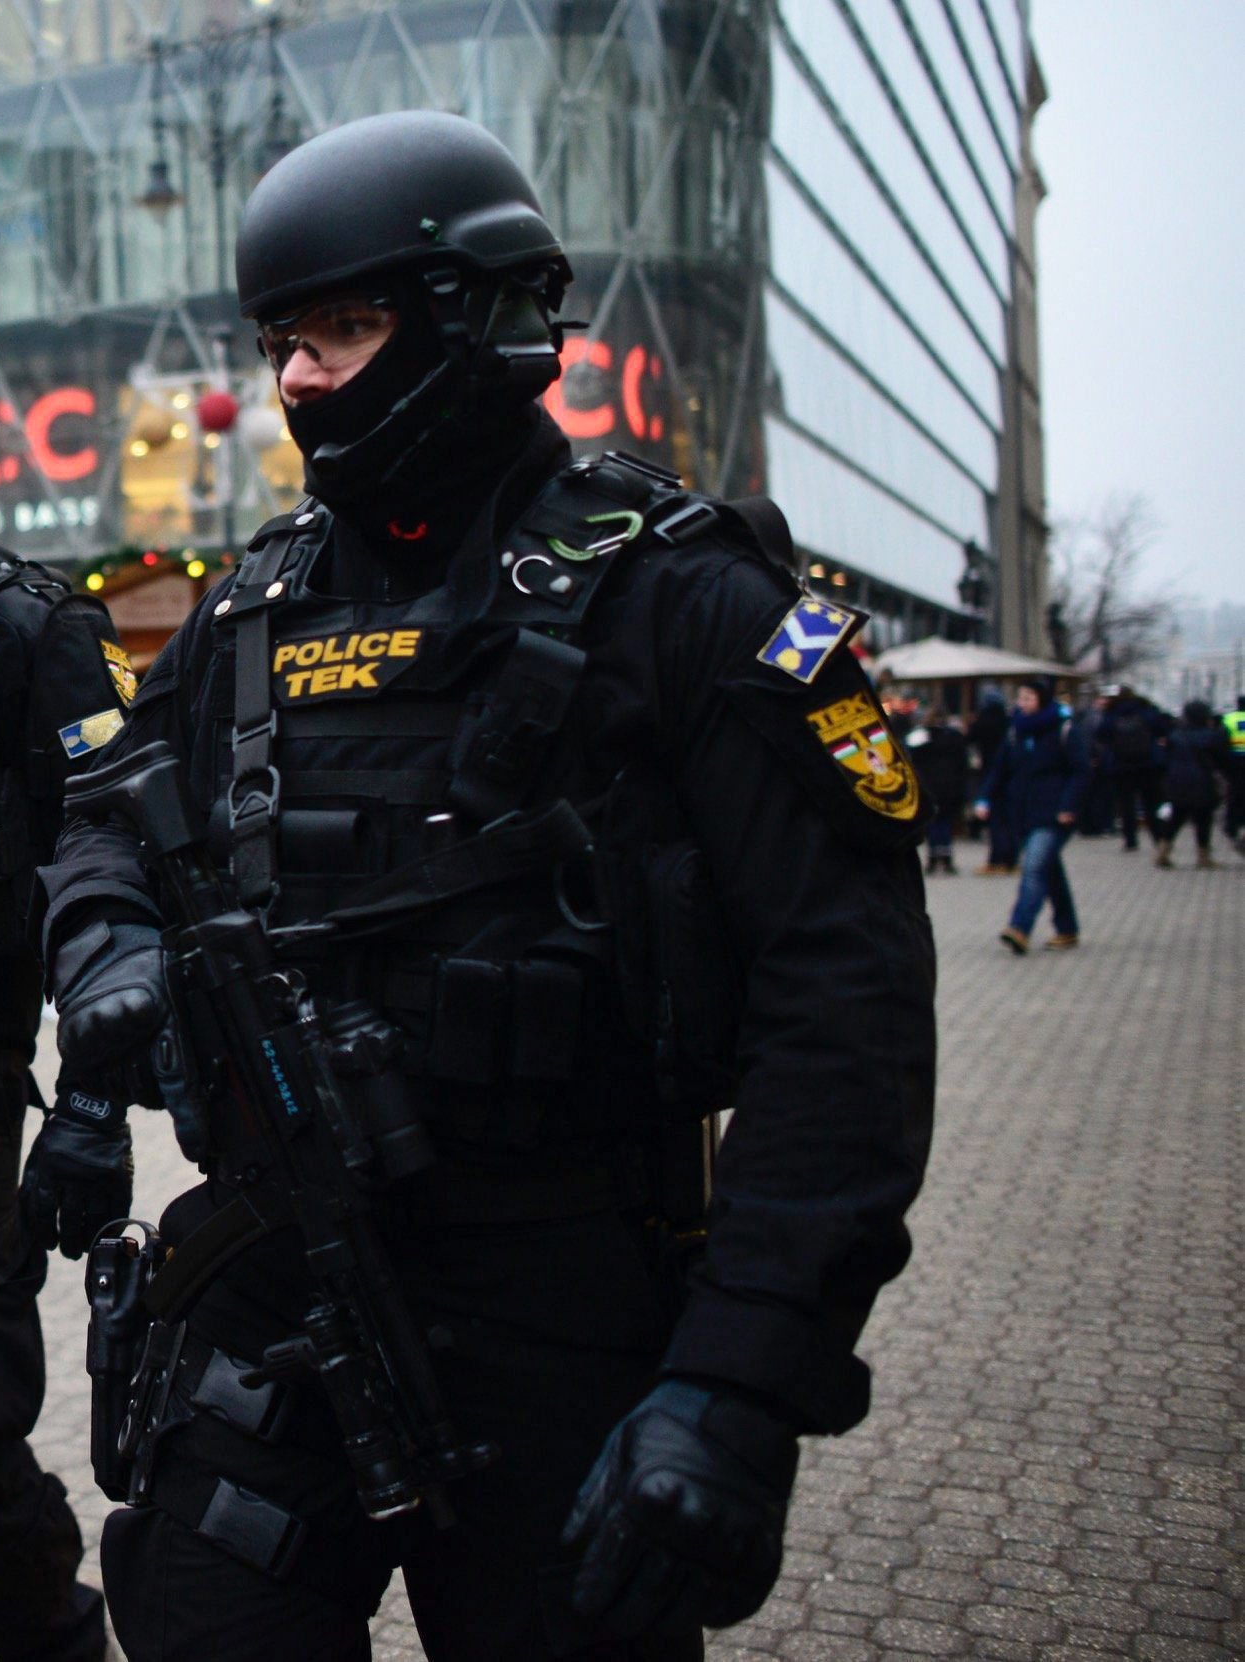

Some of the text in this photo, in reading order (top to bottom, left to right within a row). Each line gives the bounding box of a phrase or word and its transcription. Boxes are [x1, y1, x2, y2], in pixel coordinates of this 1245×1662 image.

[272, 629, 422, 673] POLICE
[285, 662, 380, 698] TEK
[806, 692, 869, 732] TEK
[74, 1095, 110, 1116] PETZL
